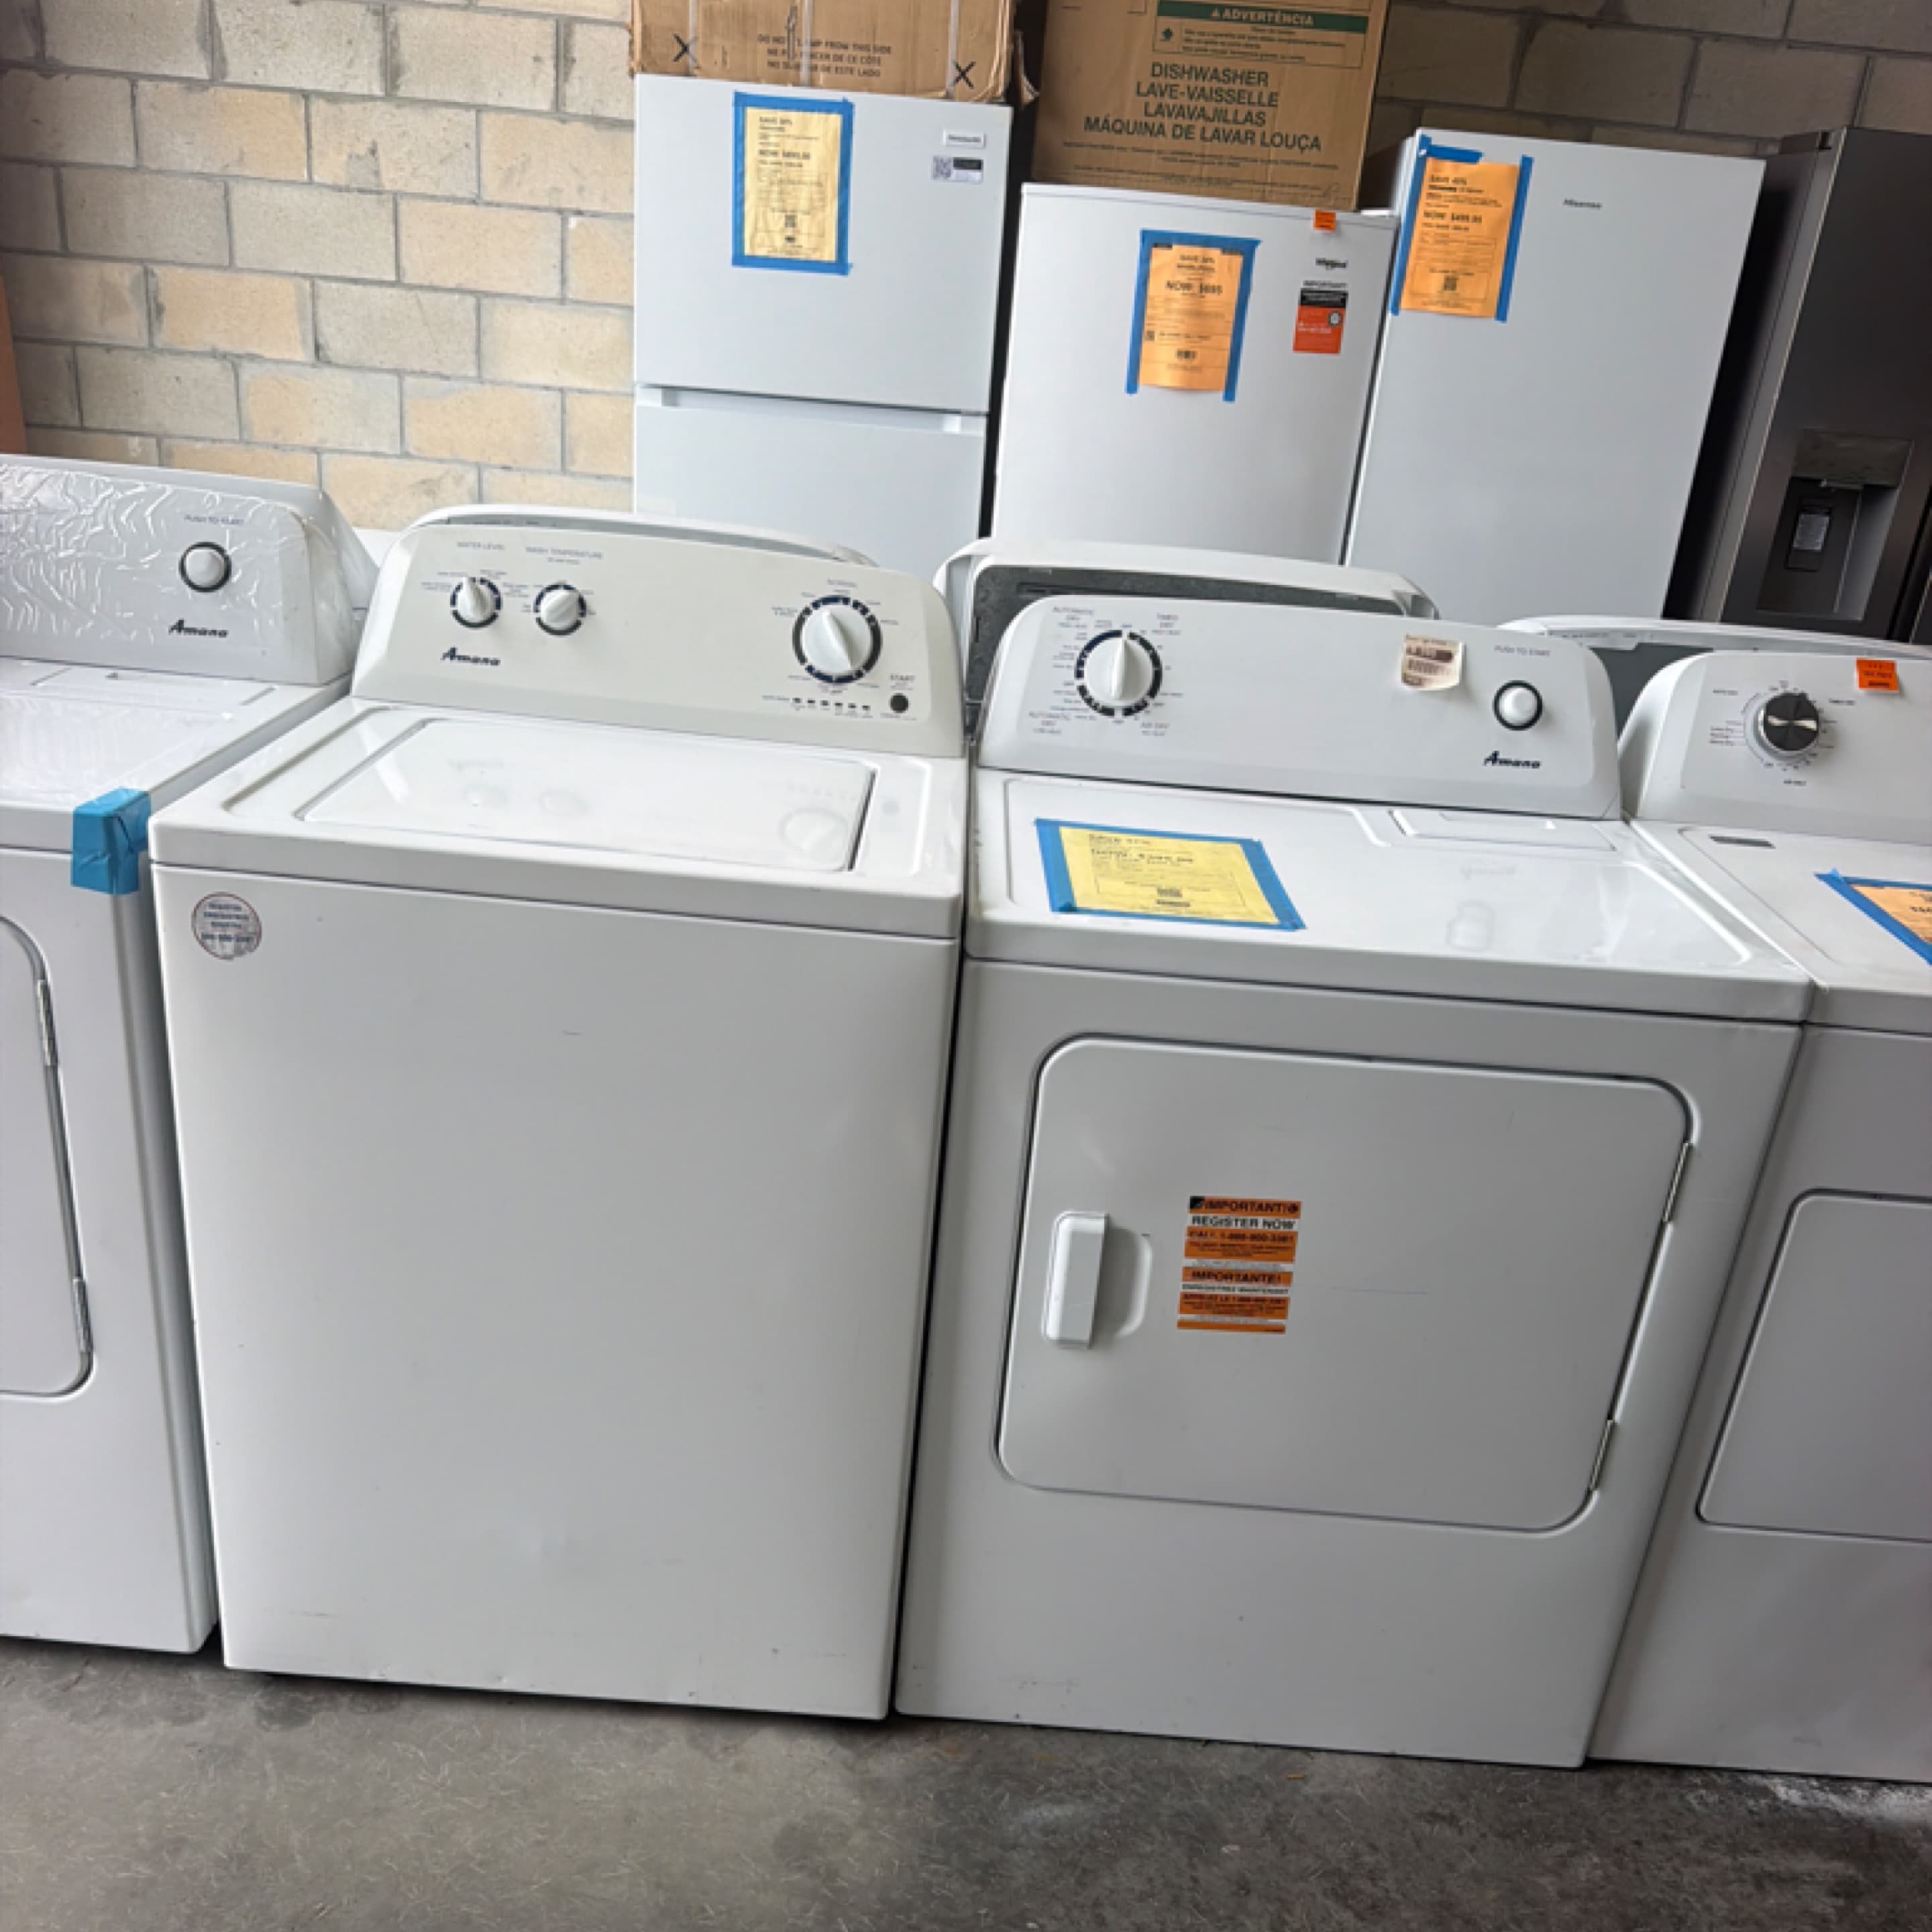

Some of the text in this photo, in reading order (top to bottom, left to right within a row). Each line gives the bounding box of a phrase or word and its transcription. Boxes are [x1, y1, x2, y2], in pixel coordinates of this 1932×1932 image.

[1150, 62, 1269, 88] DISHWASHER
[1136, 82, 1279, 107] LAVE-VAISSELLE
[1144, 102, 1267, 127] LAVAVAJILLAS
[1084, 114, 1322, 154] MÁQUINA DE LAVAR LOUÇA
[168, 619, 229, 637] Amana
[441, 647, 500, 665] Amana
[1483, 751, 1541, 769] Amana
[1192, 1216, 1295, 1230] REGISTER NOW
